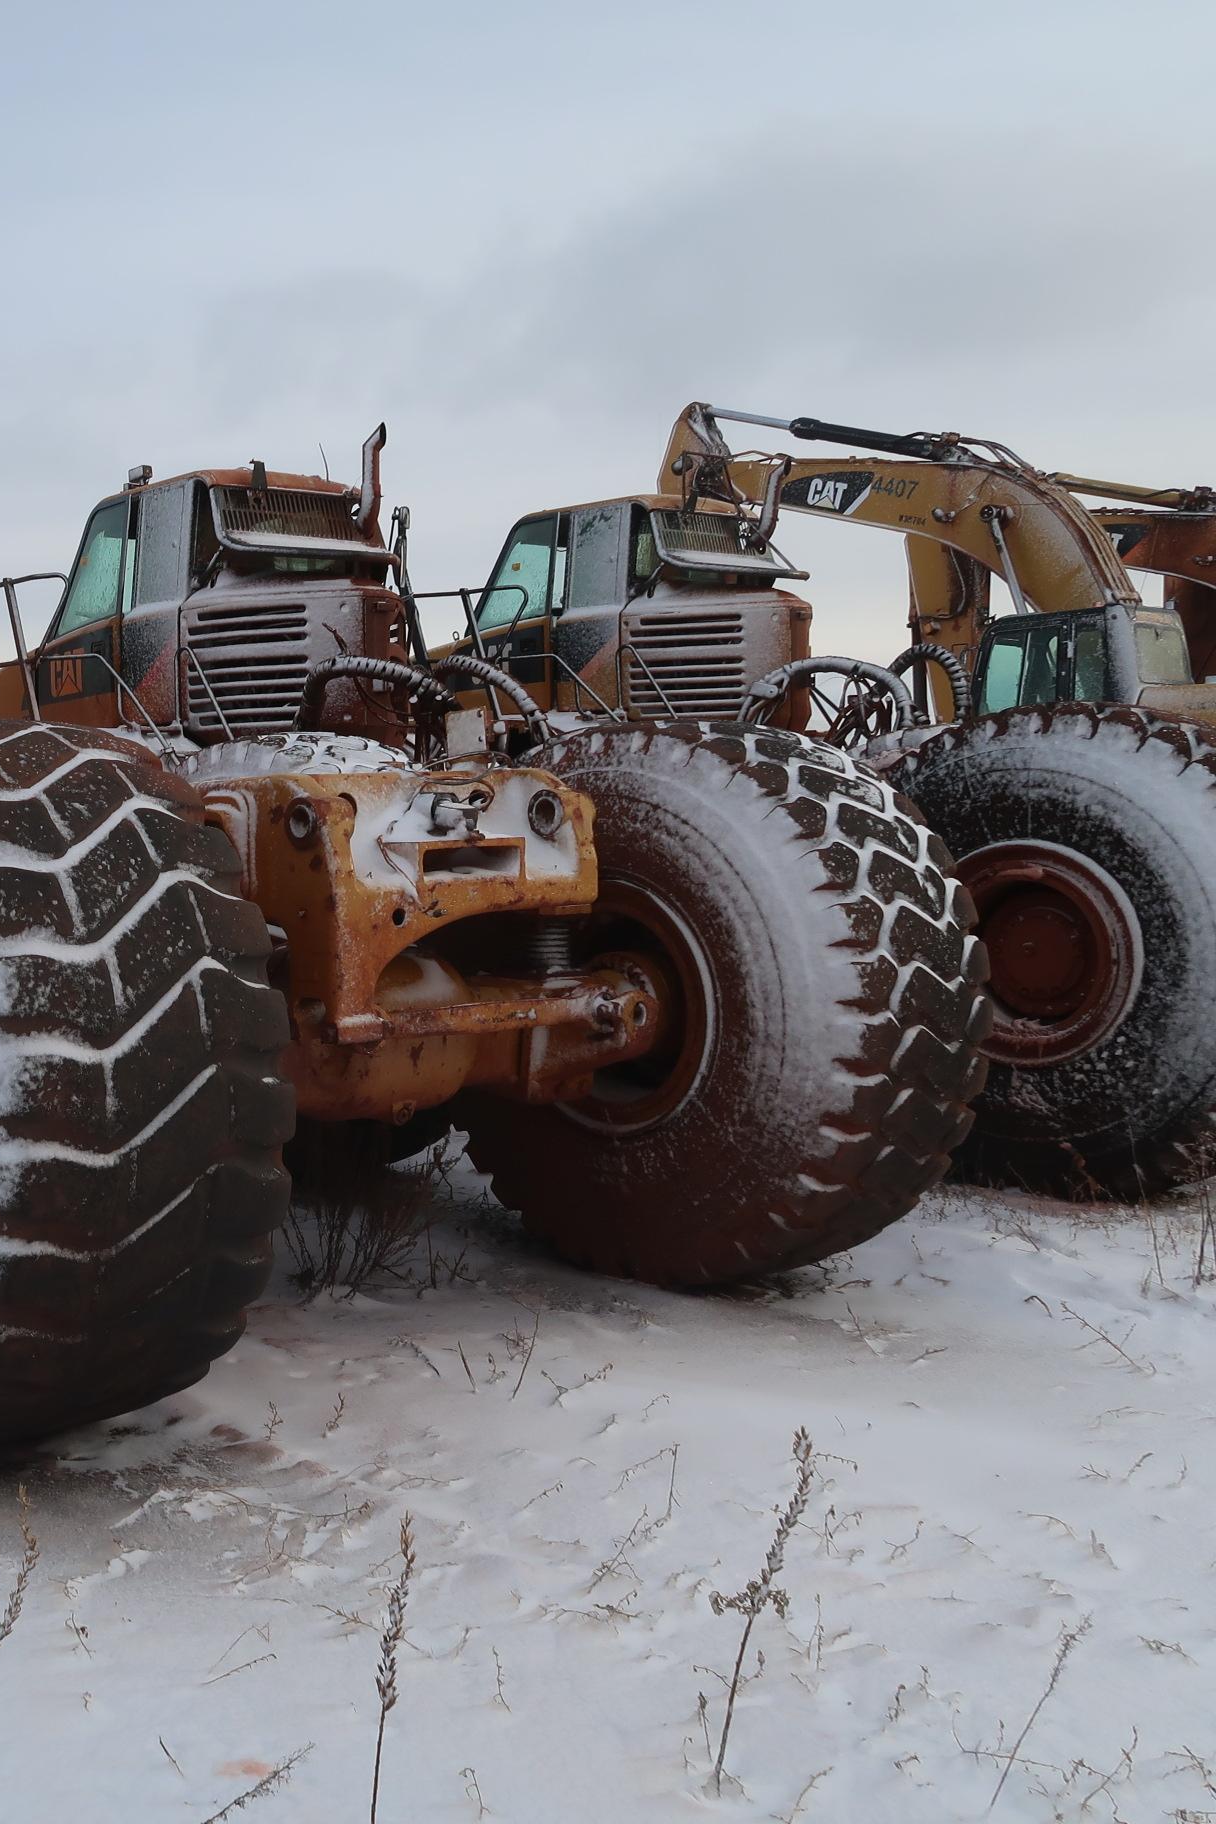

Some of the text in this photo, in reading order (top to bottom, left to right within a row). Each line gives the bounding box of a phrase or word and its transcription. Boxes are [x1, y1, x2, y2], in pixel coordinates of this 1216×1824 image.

[806, 478, 848, 510] CAT
[871, 476, 919, 500] 4407
[49, 647, 85, 698] CAT
